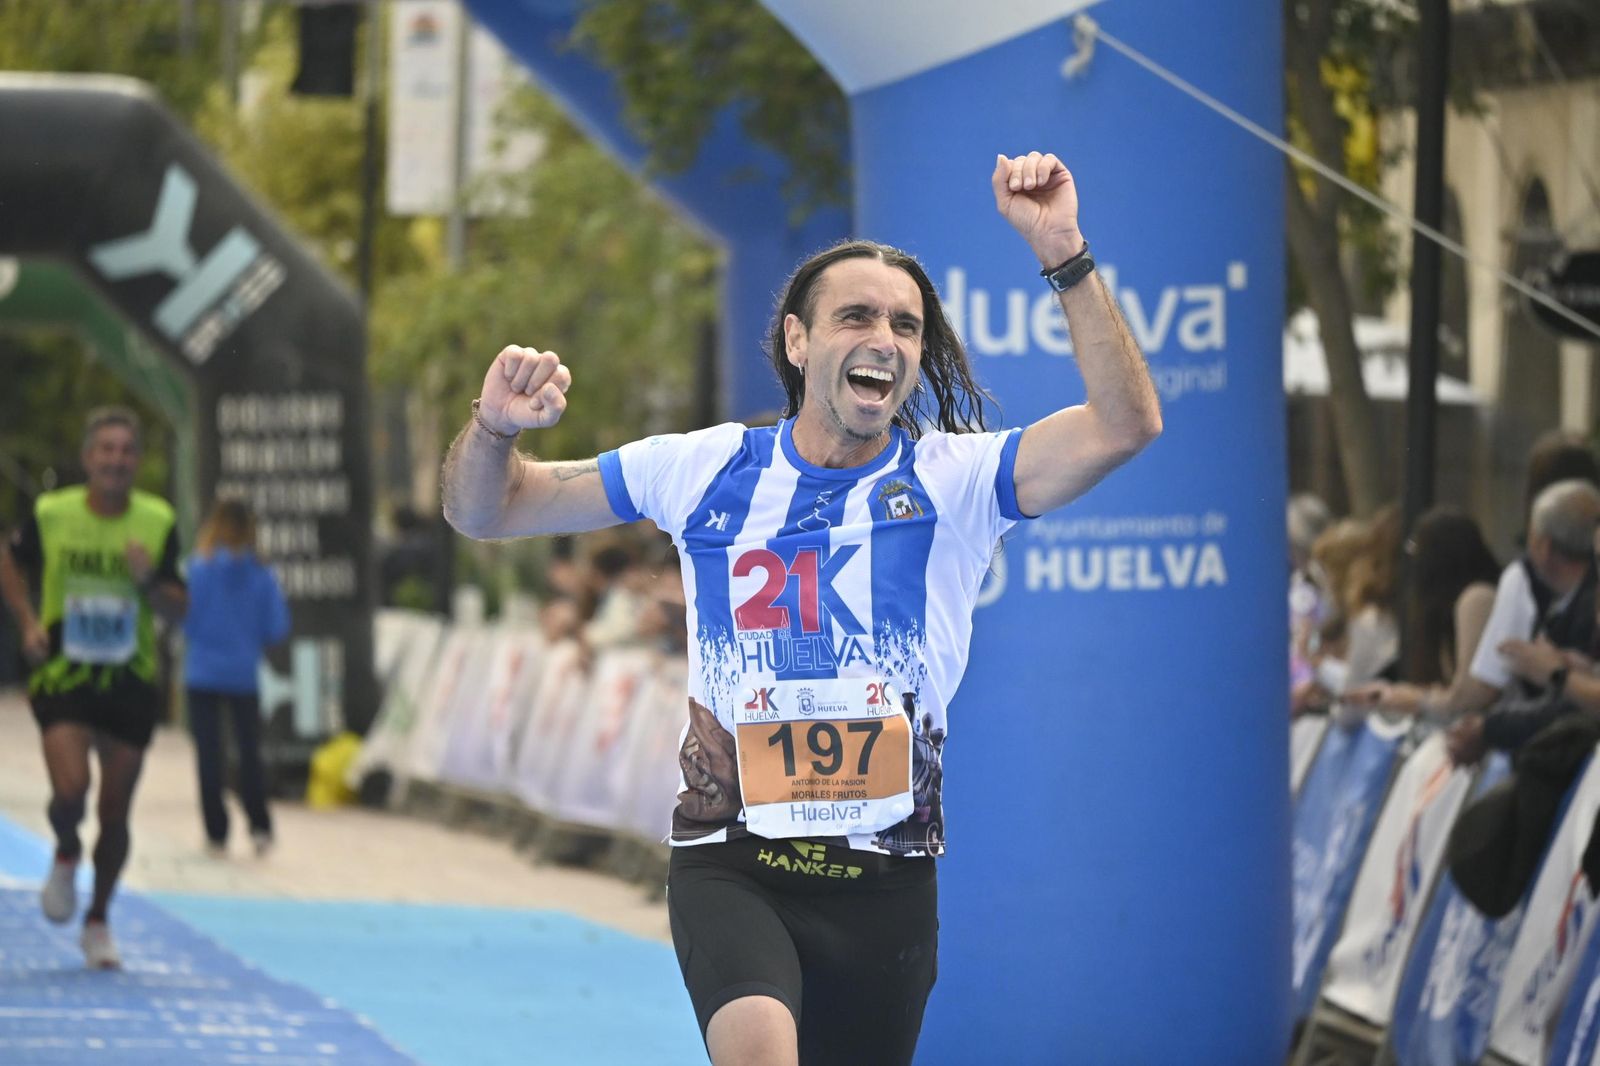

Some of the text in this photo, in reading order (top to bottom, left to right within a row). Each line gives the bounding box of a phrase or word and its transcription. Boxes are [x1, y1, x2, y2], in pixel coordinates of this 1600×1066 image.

[1025, 543, 1228, 591] HUELVA
[732, 544, 868, 637] 21K
[737, 629, 791, 641] CIUDAD DE
[739, 636, 873, 673] HUELVA
[744, 687, 779, 711] 21K
[817, 705, 848, 713] HUELVA
[744, 711, 780, 721] HUELVA
[768, 721, 884, 776] 197
[792, 778, 866, 787] ANTONIO DE LA PASION
[791, 789, 868, 800] MORALES FRUTOS
[790, 803, 862, 822] Huelva
[757, 848, 863, 878] HANKER
